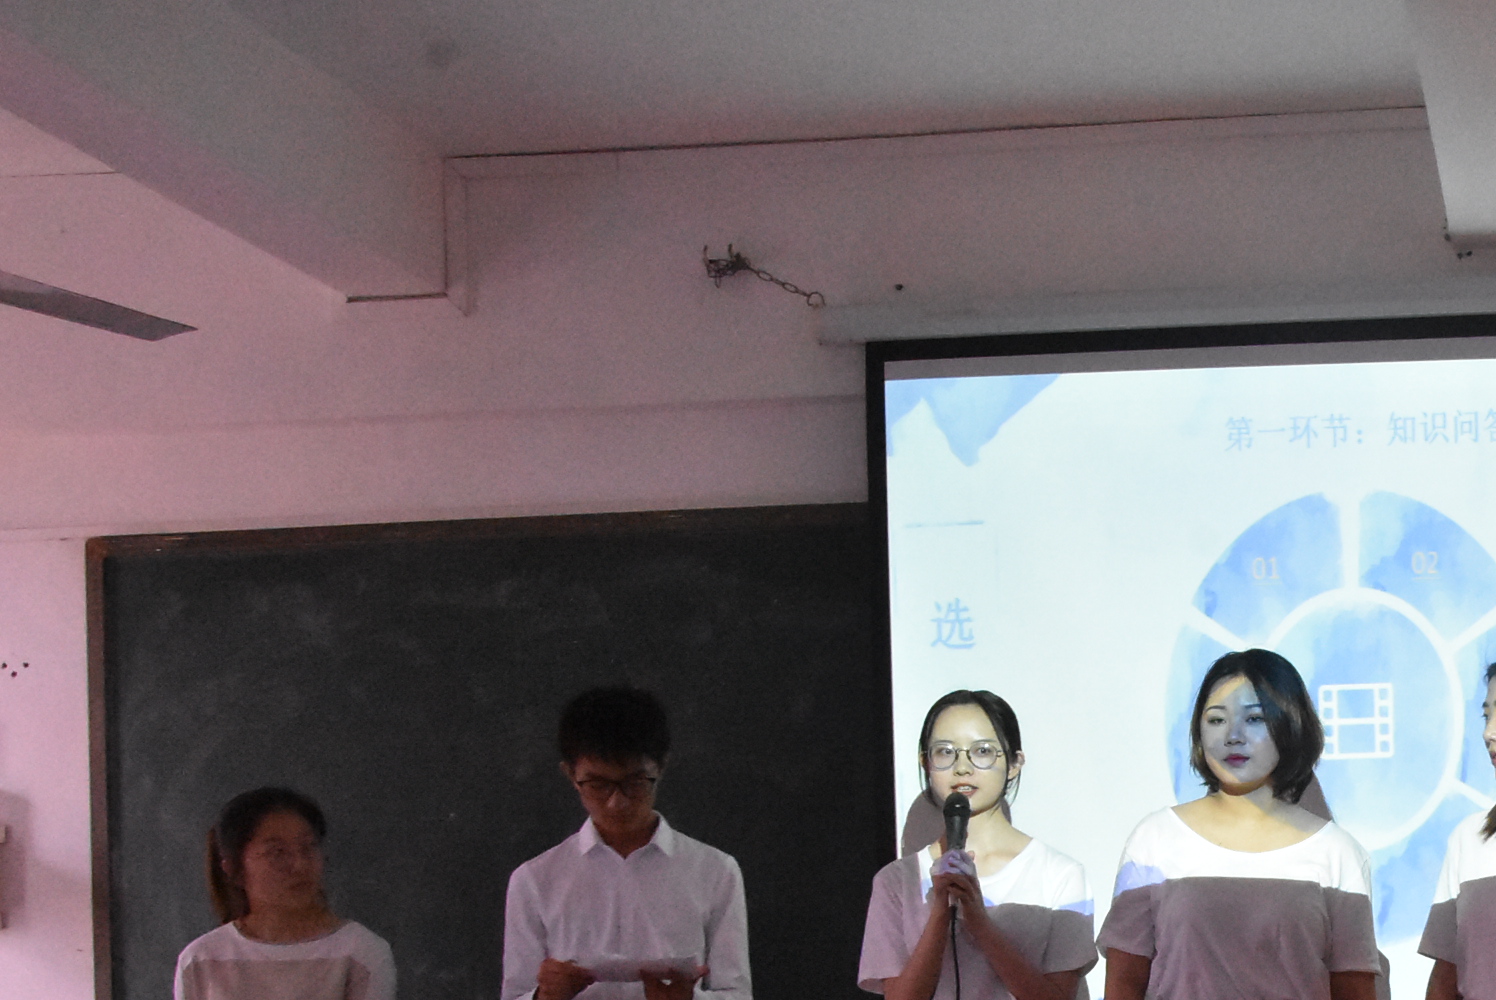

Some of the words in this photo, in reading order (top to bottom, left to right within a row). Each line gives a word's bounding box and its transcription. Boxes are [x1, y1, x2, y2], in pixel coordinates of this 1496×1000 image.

[1252, 557, 1279, 580] 01
[1411, 552, 1438, 574] 02
[930, 597, 976, 649] 选
